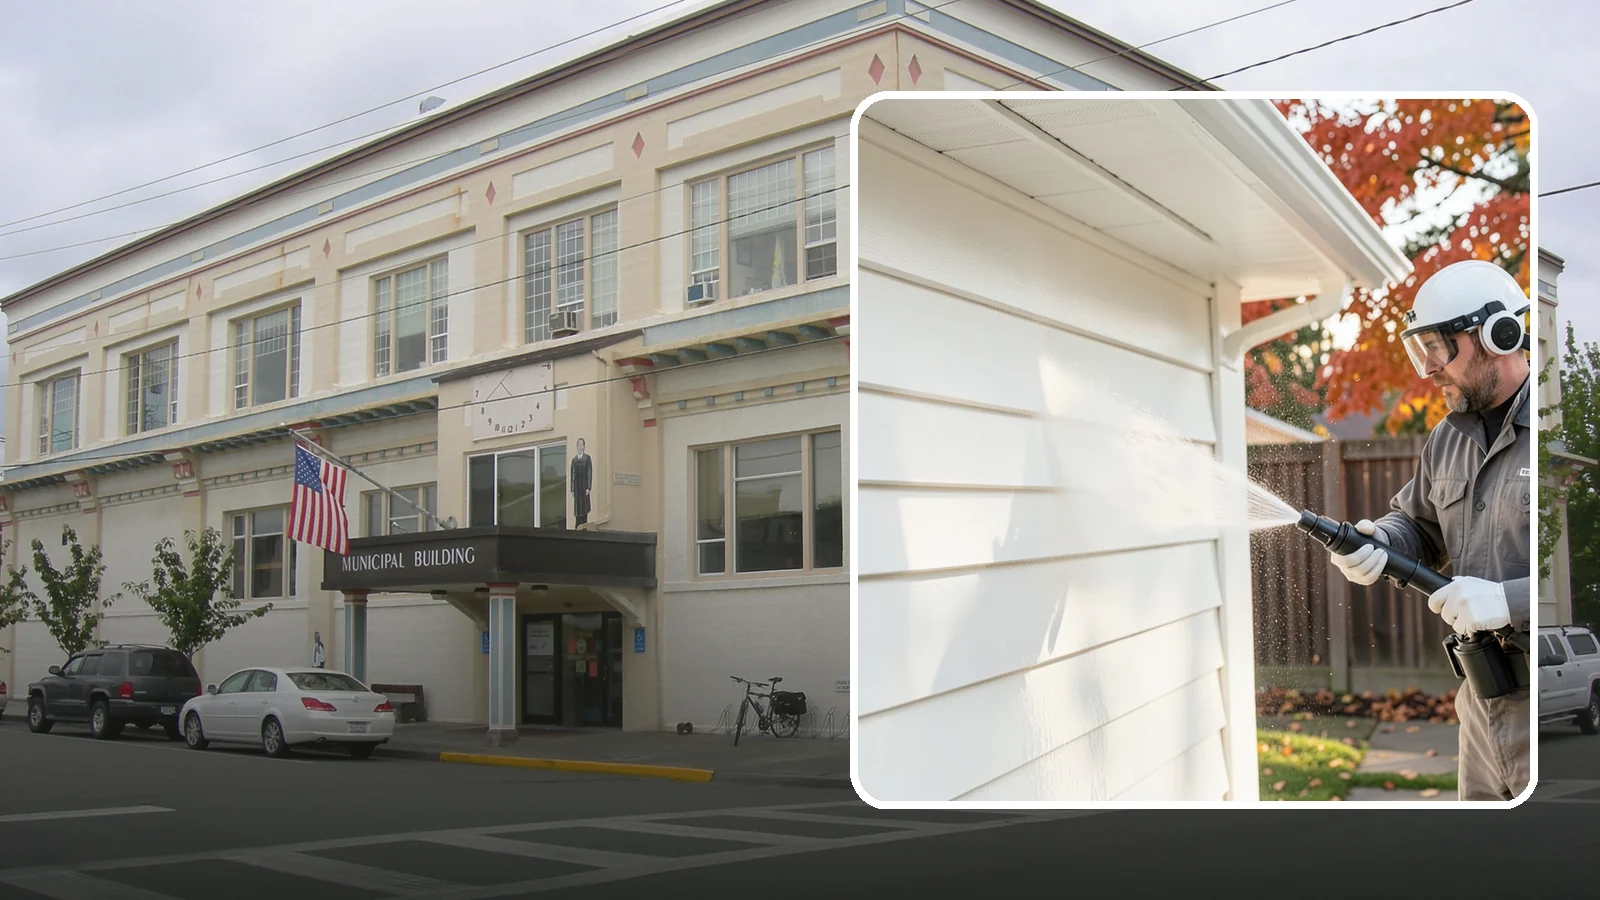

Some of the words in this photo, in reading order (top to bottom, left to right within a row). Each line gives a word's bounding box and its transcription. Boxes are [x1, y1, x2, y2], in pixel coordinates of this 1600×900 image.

[536, 402, 540, 410] 4
[481, 407, 485, 415] 8
[487, 417, 492, 426] 9
[528, 414, 533, 422] 3
[494, 423, 500, 432] 10
[521, 420, 525, 428] 2
[501, 425, 506, 433] 11
[507, 425, 513, 433] 12
[342, 552, 405, 572] MUNICIPAL
[414, 546, 475, 567] BUILDING
